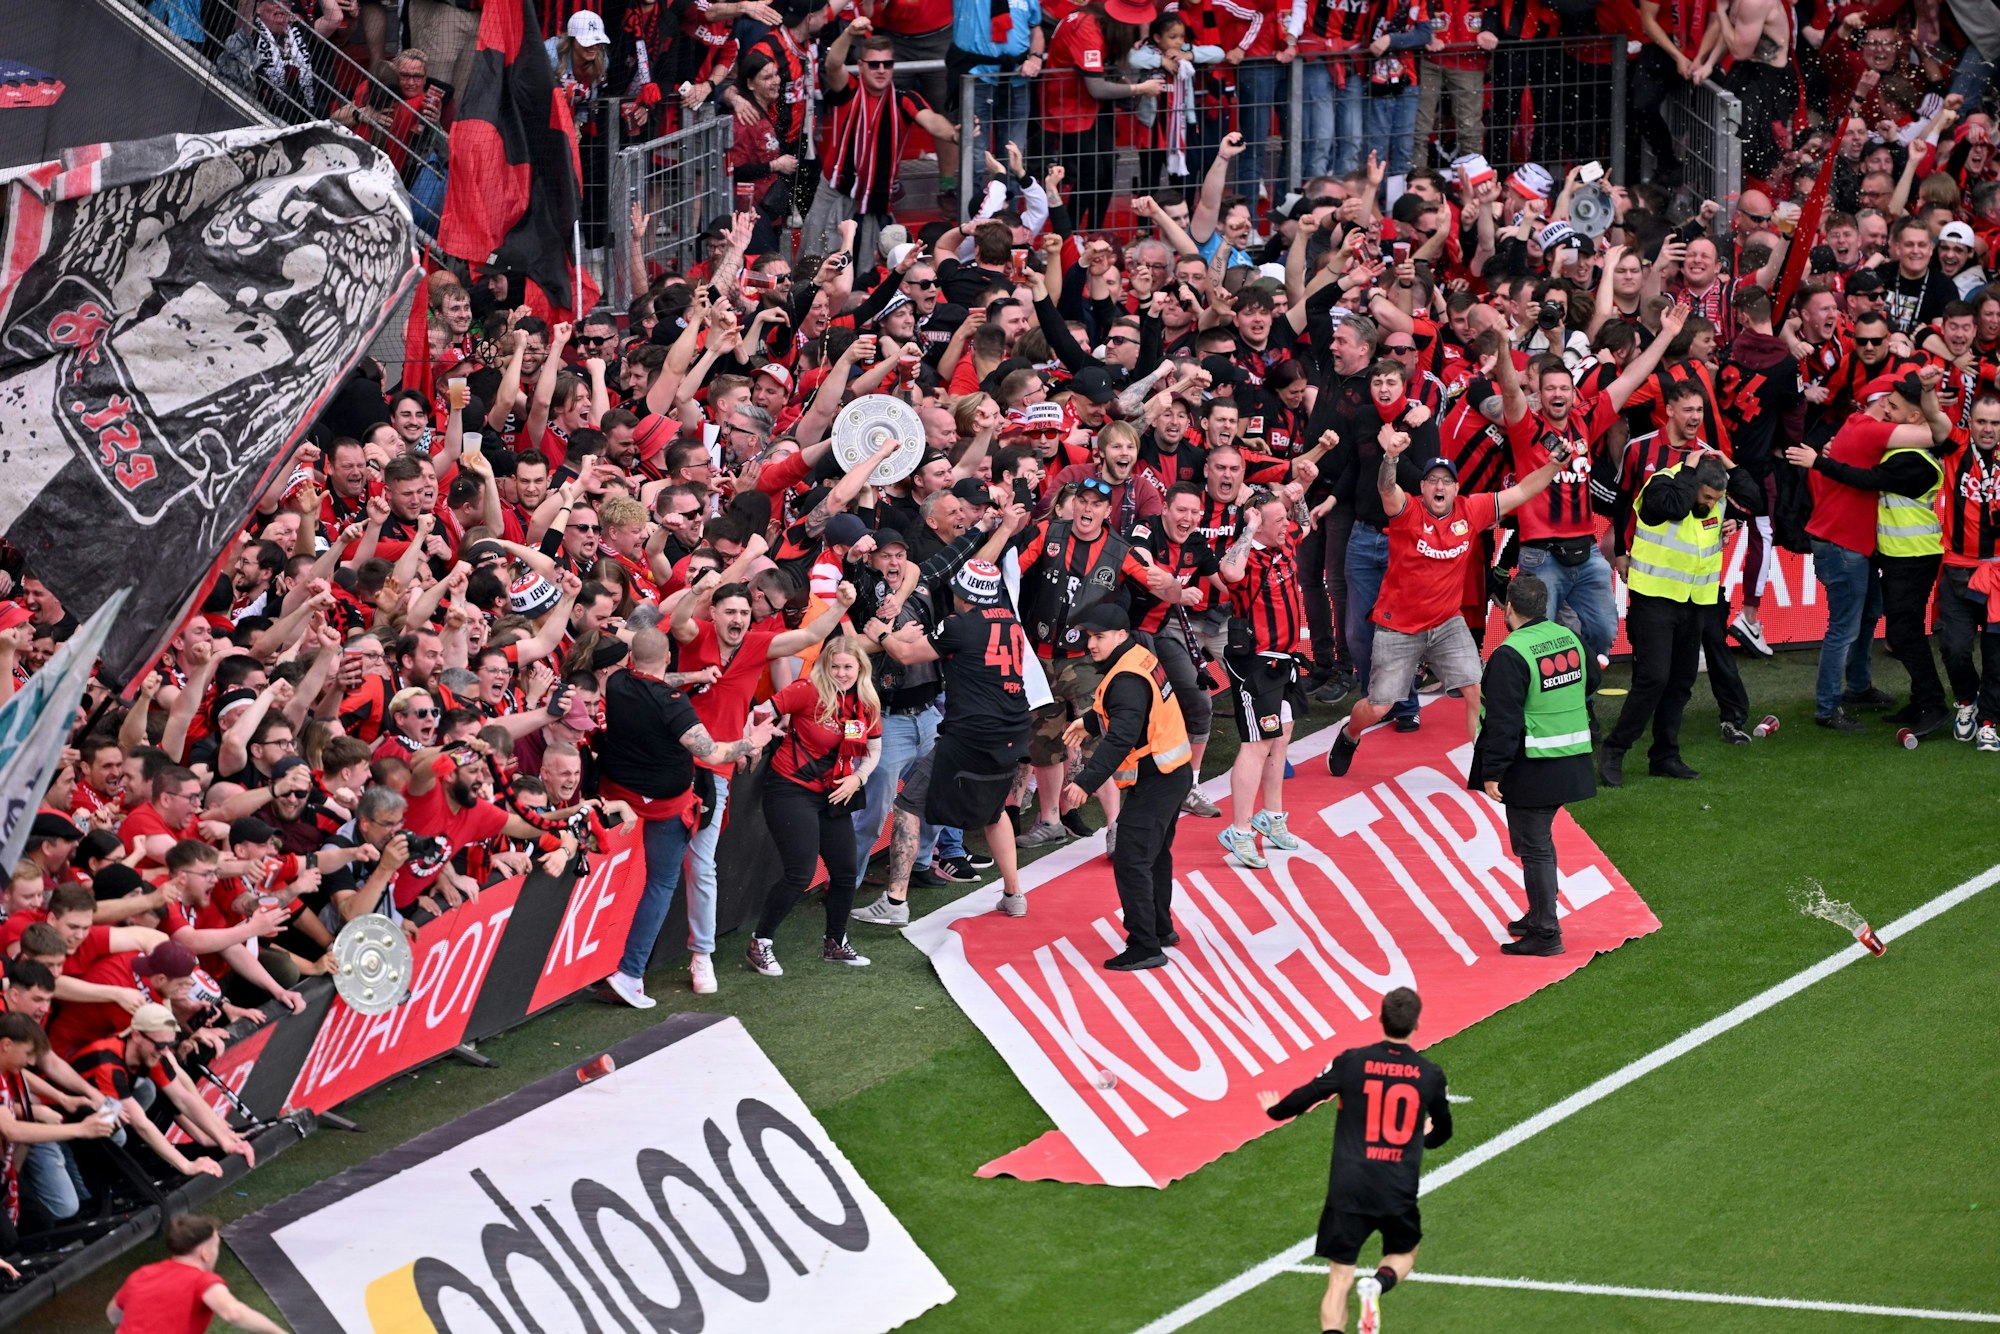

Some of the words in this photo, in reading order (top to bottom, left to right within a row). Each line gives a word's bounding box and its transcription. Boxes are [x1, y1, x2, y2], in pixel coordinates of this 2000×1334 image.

[984, 622, 1025, 677] 40
[1529, 640, 1554, 655] SECURITY
[1557, 635, 1575, 648] SERVICE
[1543, 669, 1582, 689] SECURITAS
[545, 848, 632, 976] KE
[996, 838, 1418, 1137] KUMHO
[1364, 1060, 1421, 1079] BAYER04
[1362, 1080, 1421, 1145] 10
[1366, 1146, 1404, 1162] WIRTZ
